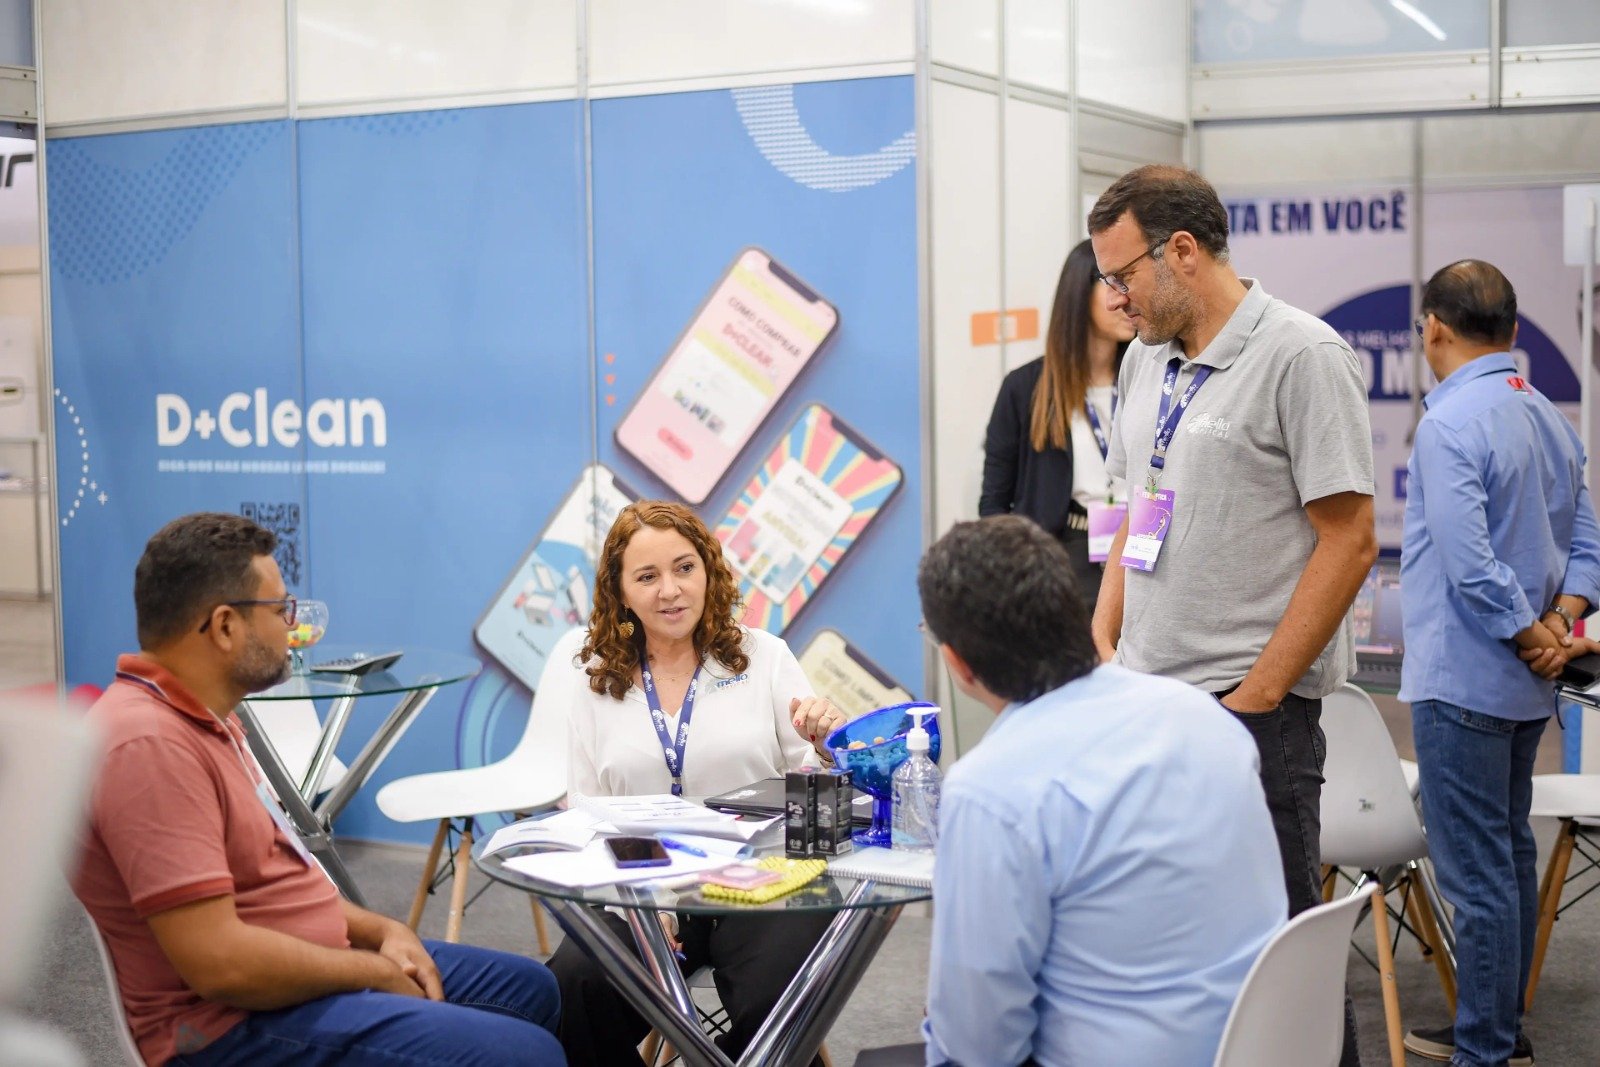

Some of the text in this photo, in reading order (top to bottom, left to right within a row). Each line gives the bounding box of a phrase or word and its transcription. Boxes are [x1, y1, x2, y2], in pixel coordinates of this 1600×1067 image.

[1271, 202, 1311, 232] EM
[1323, 191, 1405, 232] VOCÊ
[727, 297, 756, 322] COMO
[156, 388, 387, 448] D+Clean
